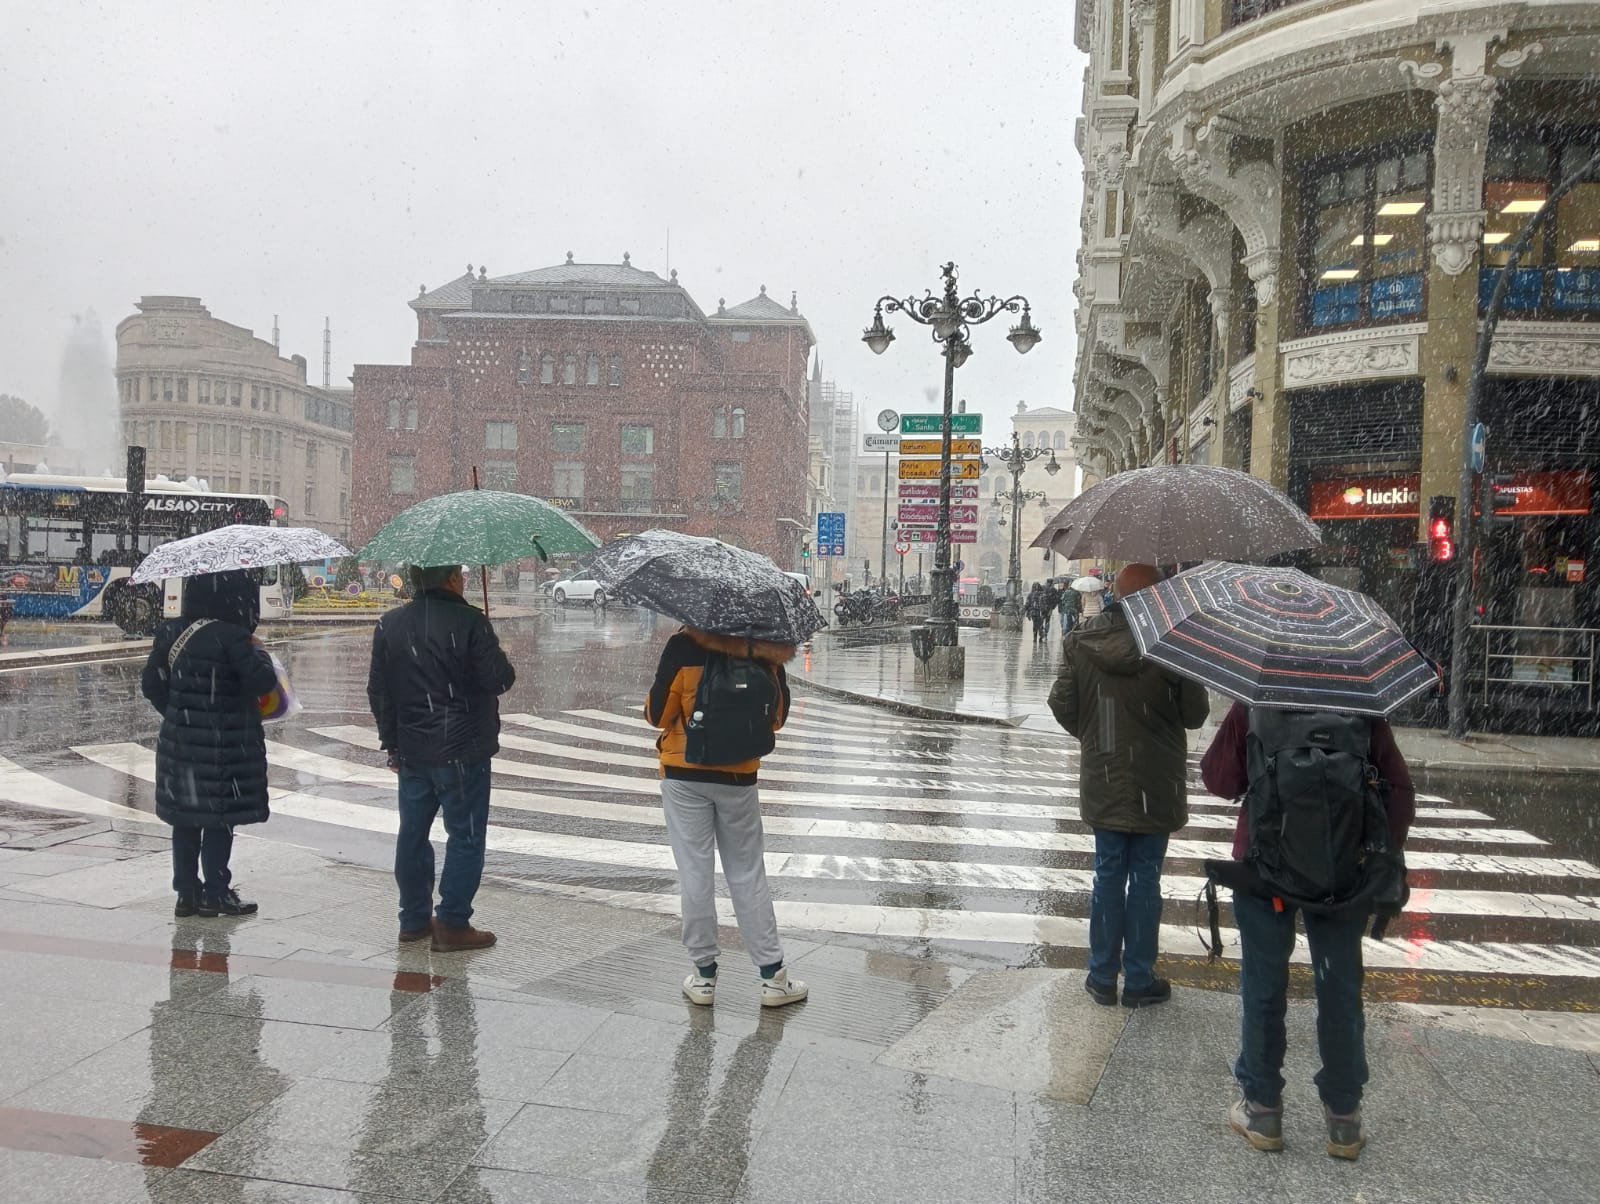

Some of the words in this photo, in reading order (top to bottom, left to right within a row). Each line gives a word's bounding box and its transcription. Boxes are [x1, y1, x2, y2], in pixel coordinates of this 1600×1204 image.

[1377, 298, 1416, 312] Allianz
[1499, 486, 1534, 494] APUESTAS
[144, 499, 185, 511] ALSA
[1441, 541, 1451, 559] 3
